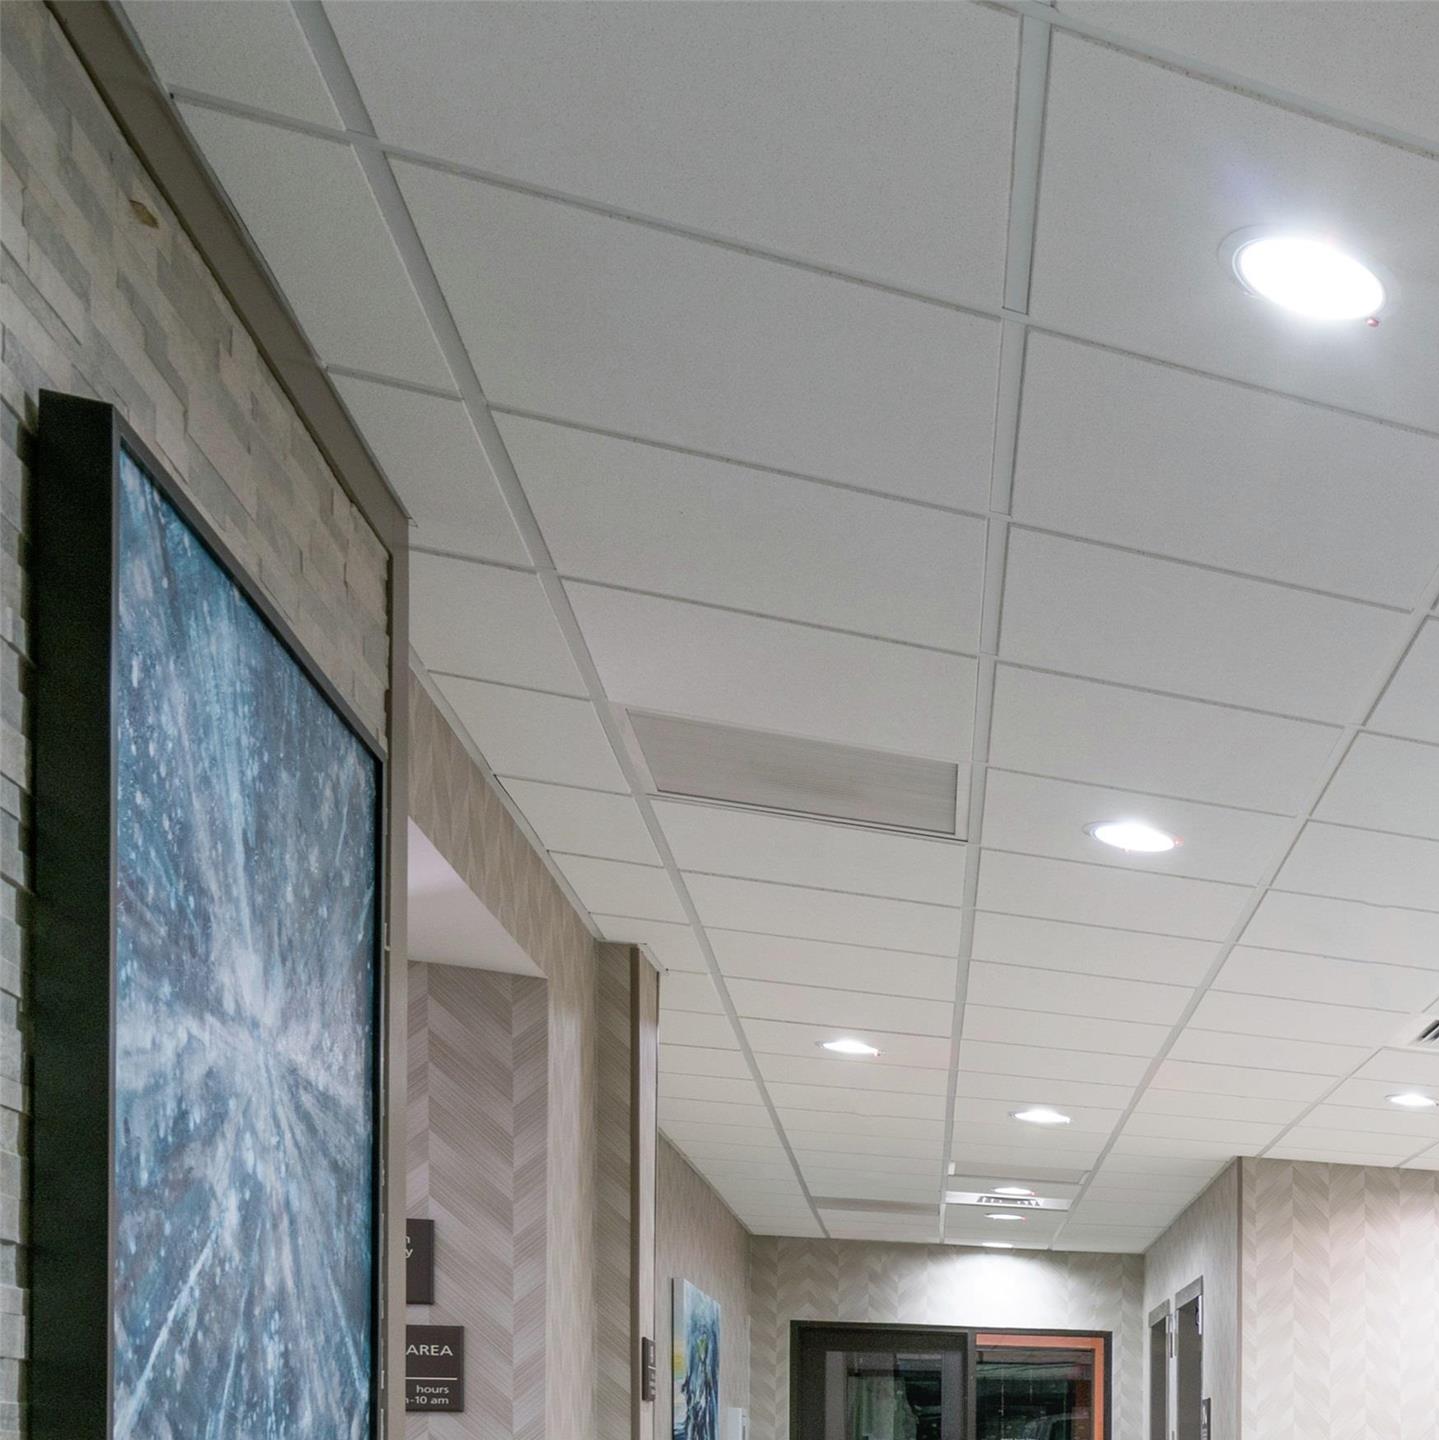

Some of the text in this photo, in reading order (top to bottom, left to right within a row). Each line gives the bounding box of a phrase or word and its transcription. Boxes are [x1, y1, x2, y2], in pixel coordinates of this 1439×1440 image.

[406, 1344, 454, 1356] AREA
[416, 1384, 449, 1394] hours
[406, 1396, 428, 1404] -10
